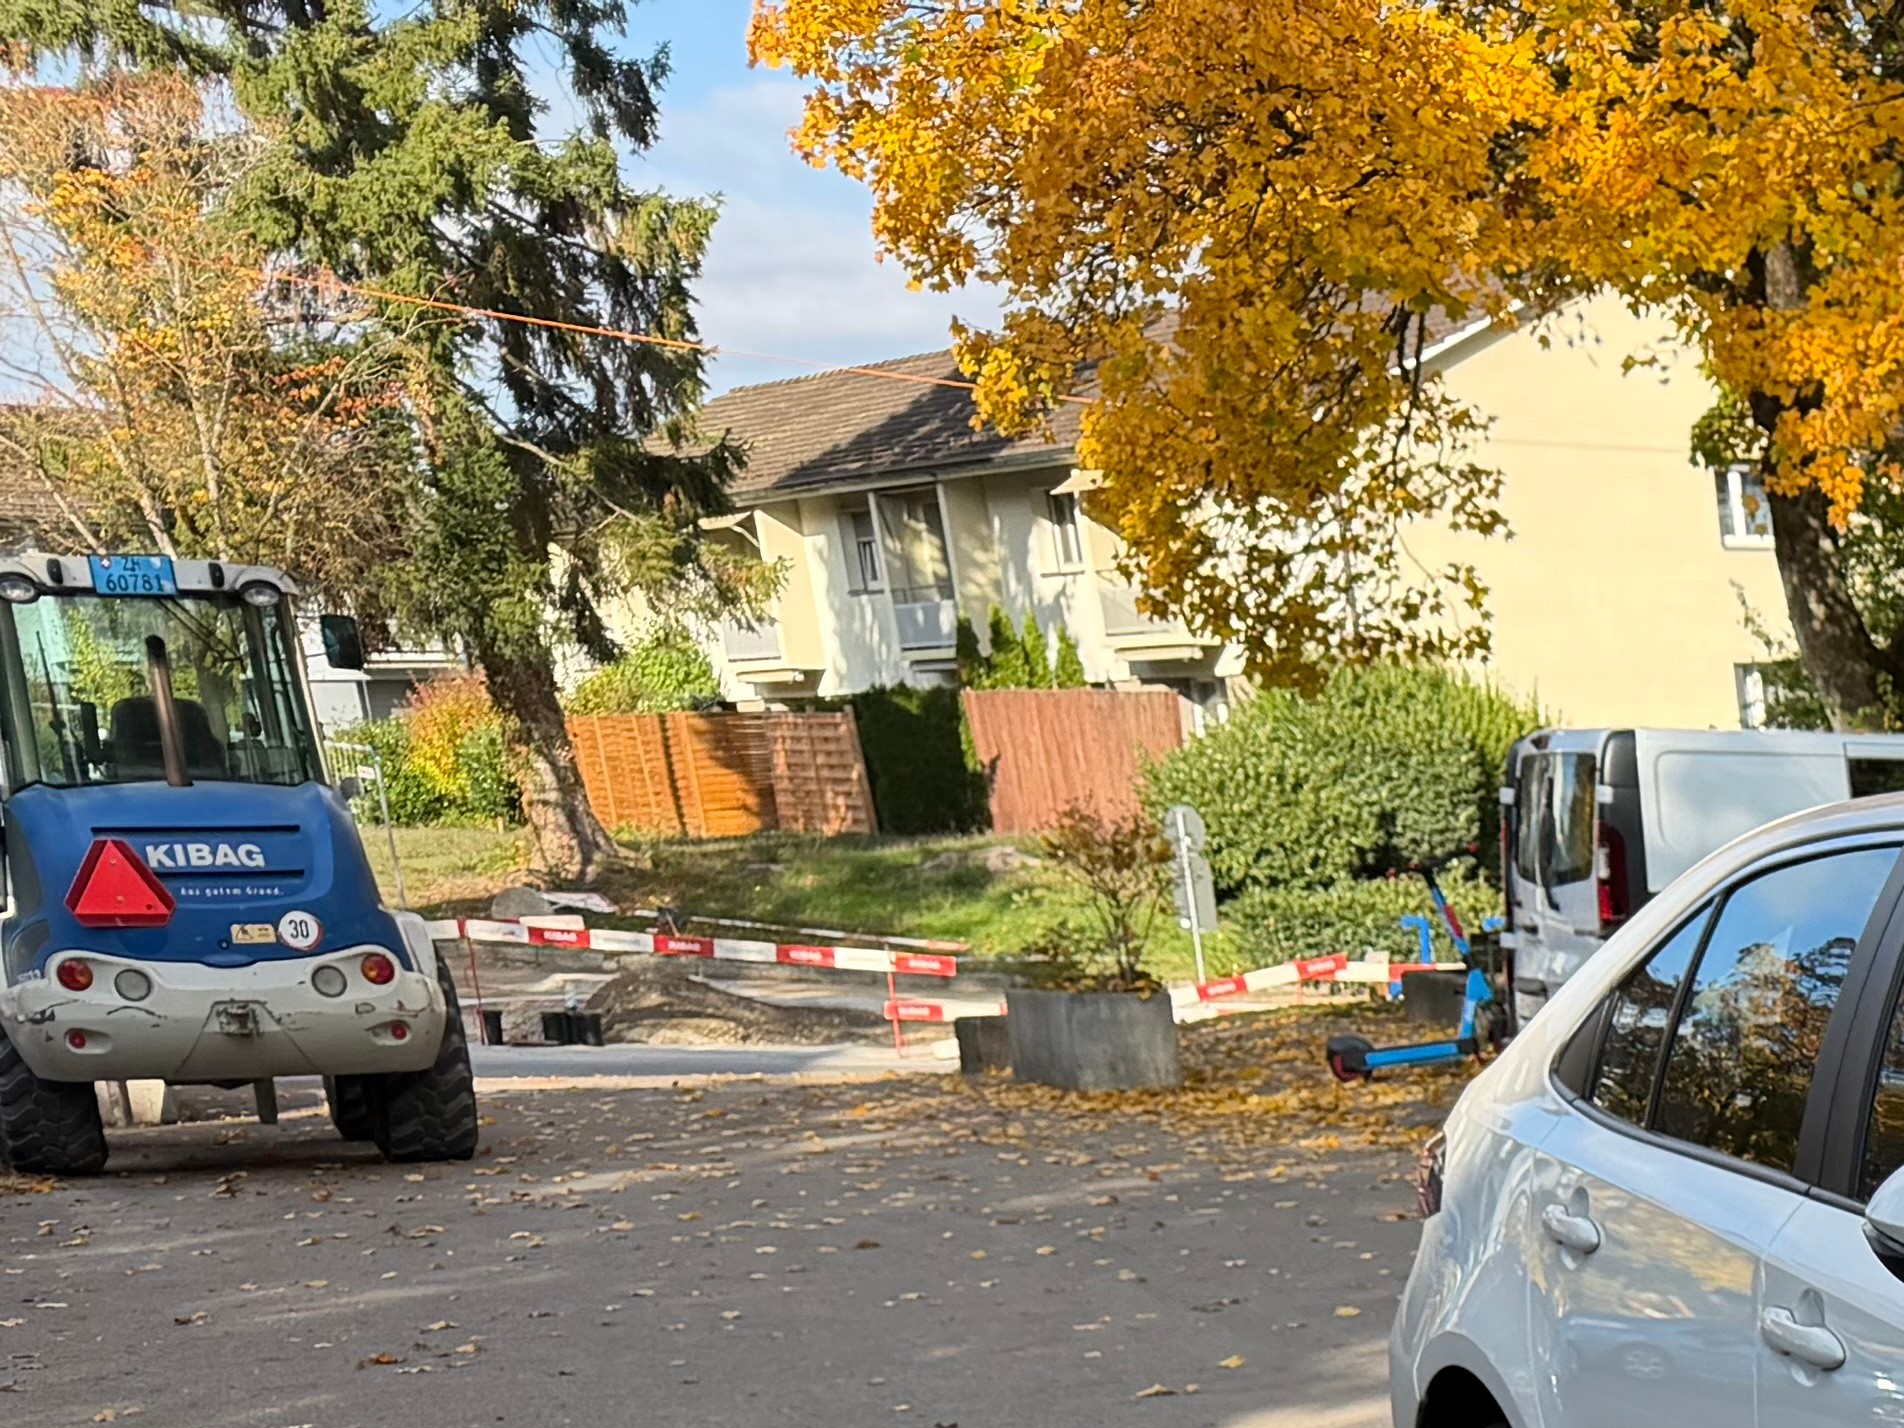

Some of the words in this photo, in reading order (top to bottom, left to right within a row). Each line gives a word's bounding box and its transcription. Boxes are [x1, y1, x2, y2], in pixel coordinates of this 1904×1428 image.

[106, 573, 164, 592] 60781
[145, 843, 265, 869] KIBAG
[289, 919, 310, 939] 30
